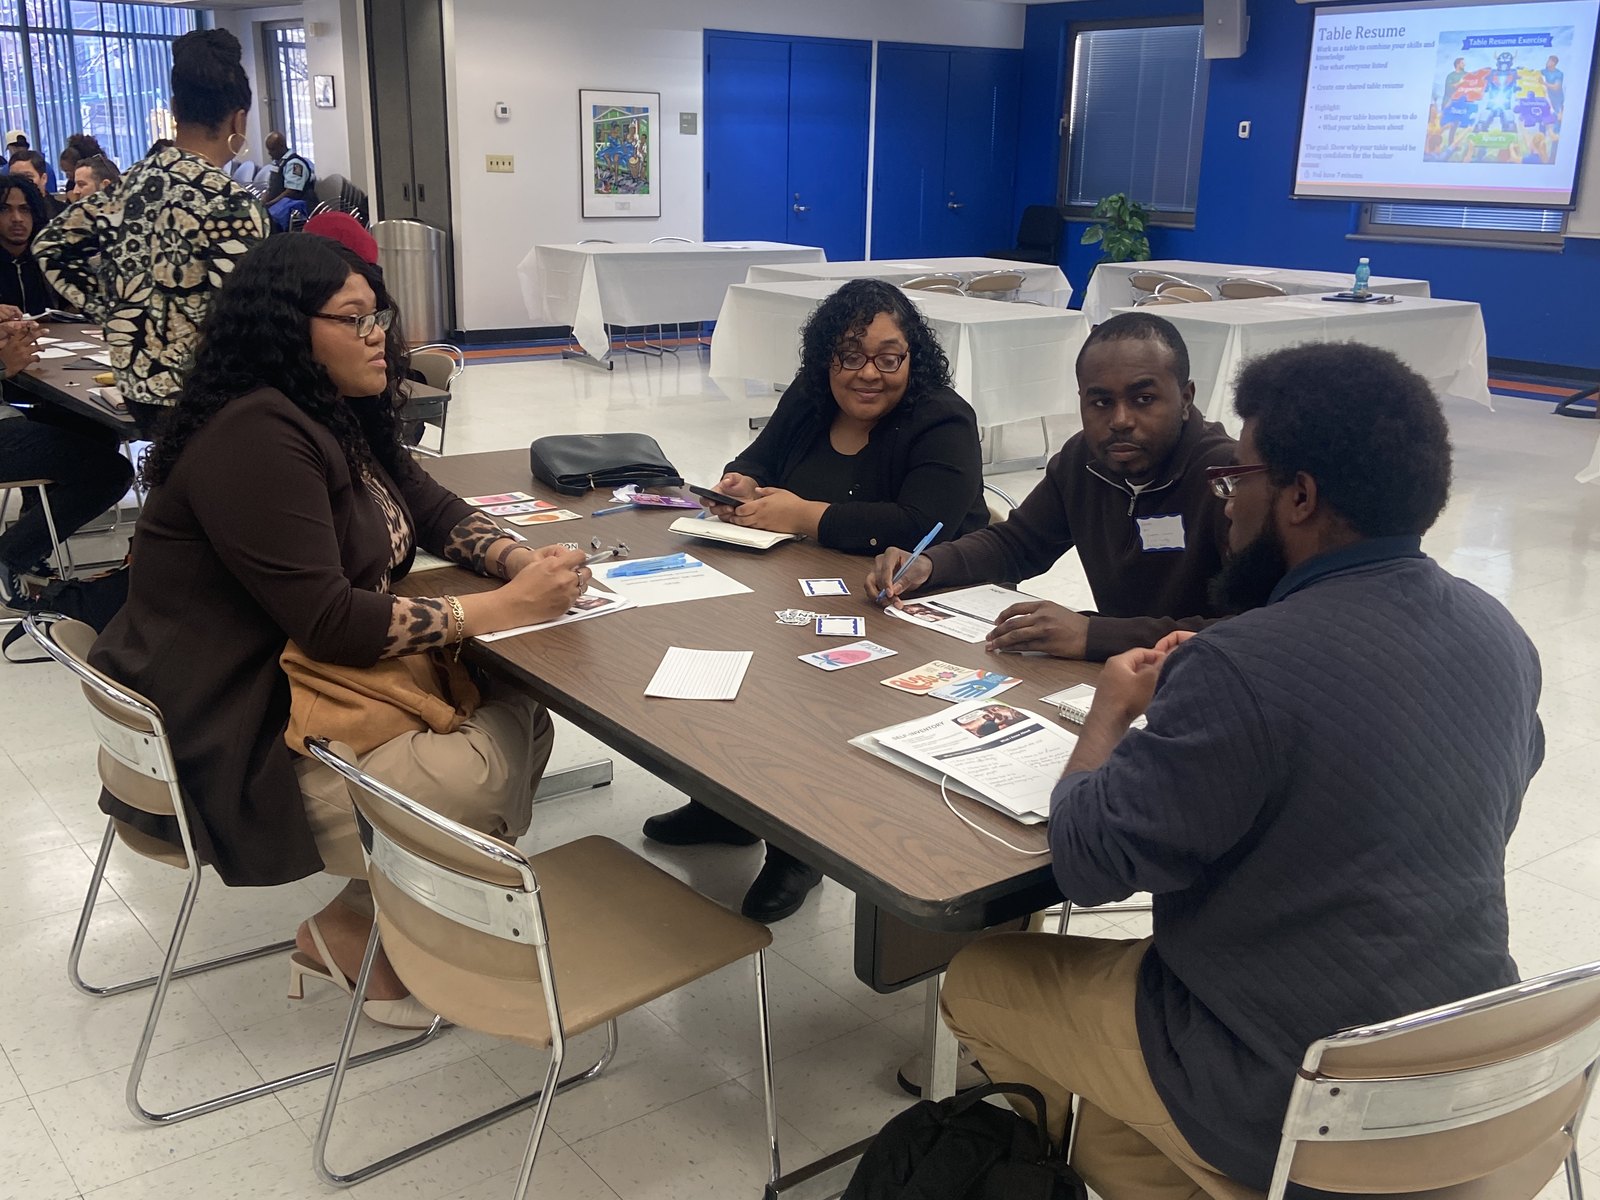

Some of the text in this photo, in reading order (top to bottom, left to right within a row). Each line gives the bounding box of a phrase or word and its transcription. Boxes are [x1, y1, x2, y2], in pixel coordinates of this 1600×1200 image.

[1319, 26, 1406, 40] Table Resume
[1518, 36, 1547, 44] Exercise
[891, 721, 945, 741] SELF-INVENTORY
